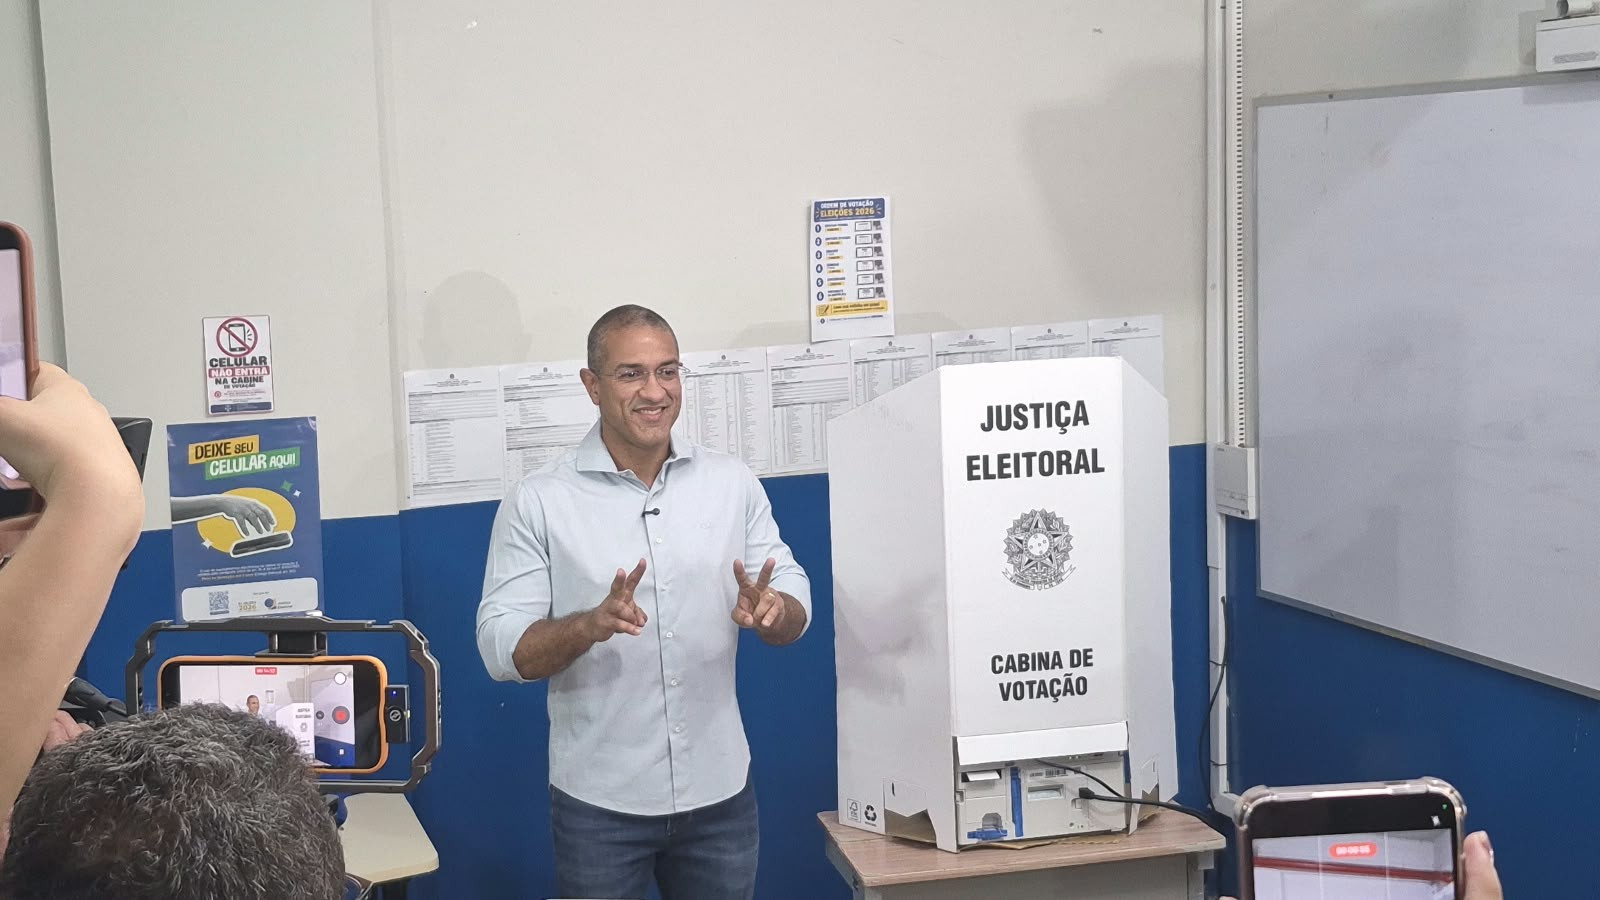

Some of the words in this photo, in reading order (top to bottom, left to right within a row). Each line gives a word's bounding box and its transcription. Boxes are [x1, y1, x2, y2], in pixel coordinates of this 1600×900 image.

[820, 208, 854, 218] ELEIÇÕES
[855, 207, 875, 216] 2026
[848, 200, 874, 208] VOTAÇÃO
[209, 355, 268, 368] CELULAR
[235, 366, 268, 376] ENTRA
[214, 377, 229, 385] NA
[231, 375, 264, 384] CABINE
[980, 400, 1090, 435] JUSTIÇA
[195, 441, 231, 460] DEIXE
[234, 442, 254, 454] SEU
[209, 453, 267, 476] CELULAR
[269, 452, 296, 469] AQUI!
[966, 448, 1105, 481] ELEITORAL
[991, 650, 1064, 674] CABINA
[1069, 648, 1094, 668] DE
[998, 672, 1088, 703] VOTAÇÃO
